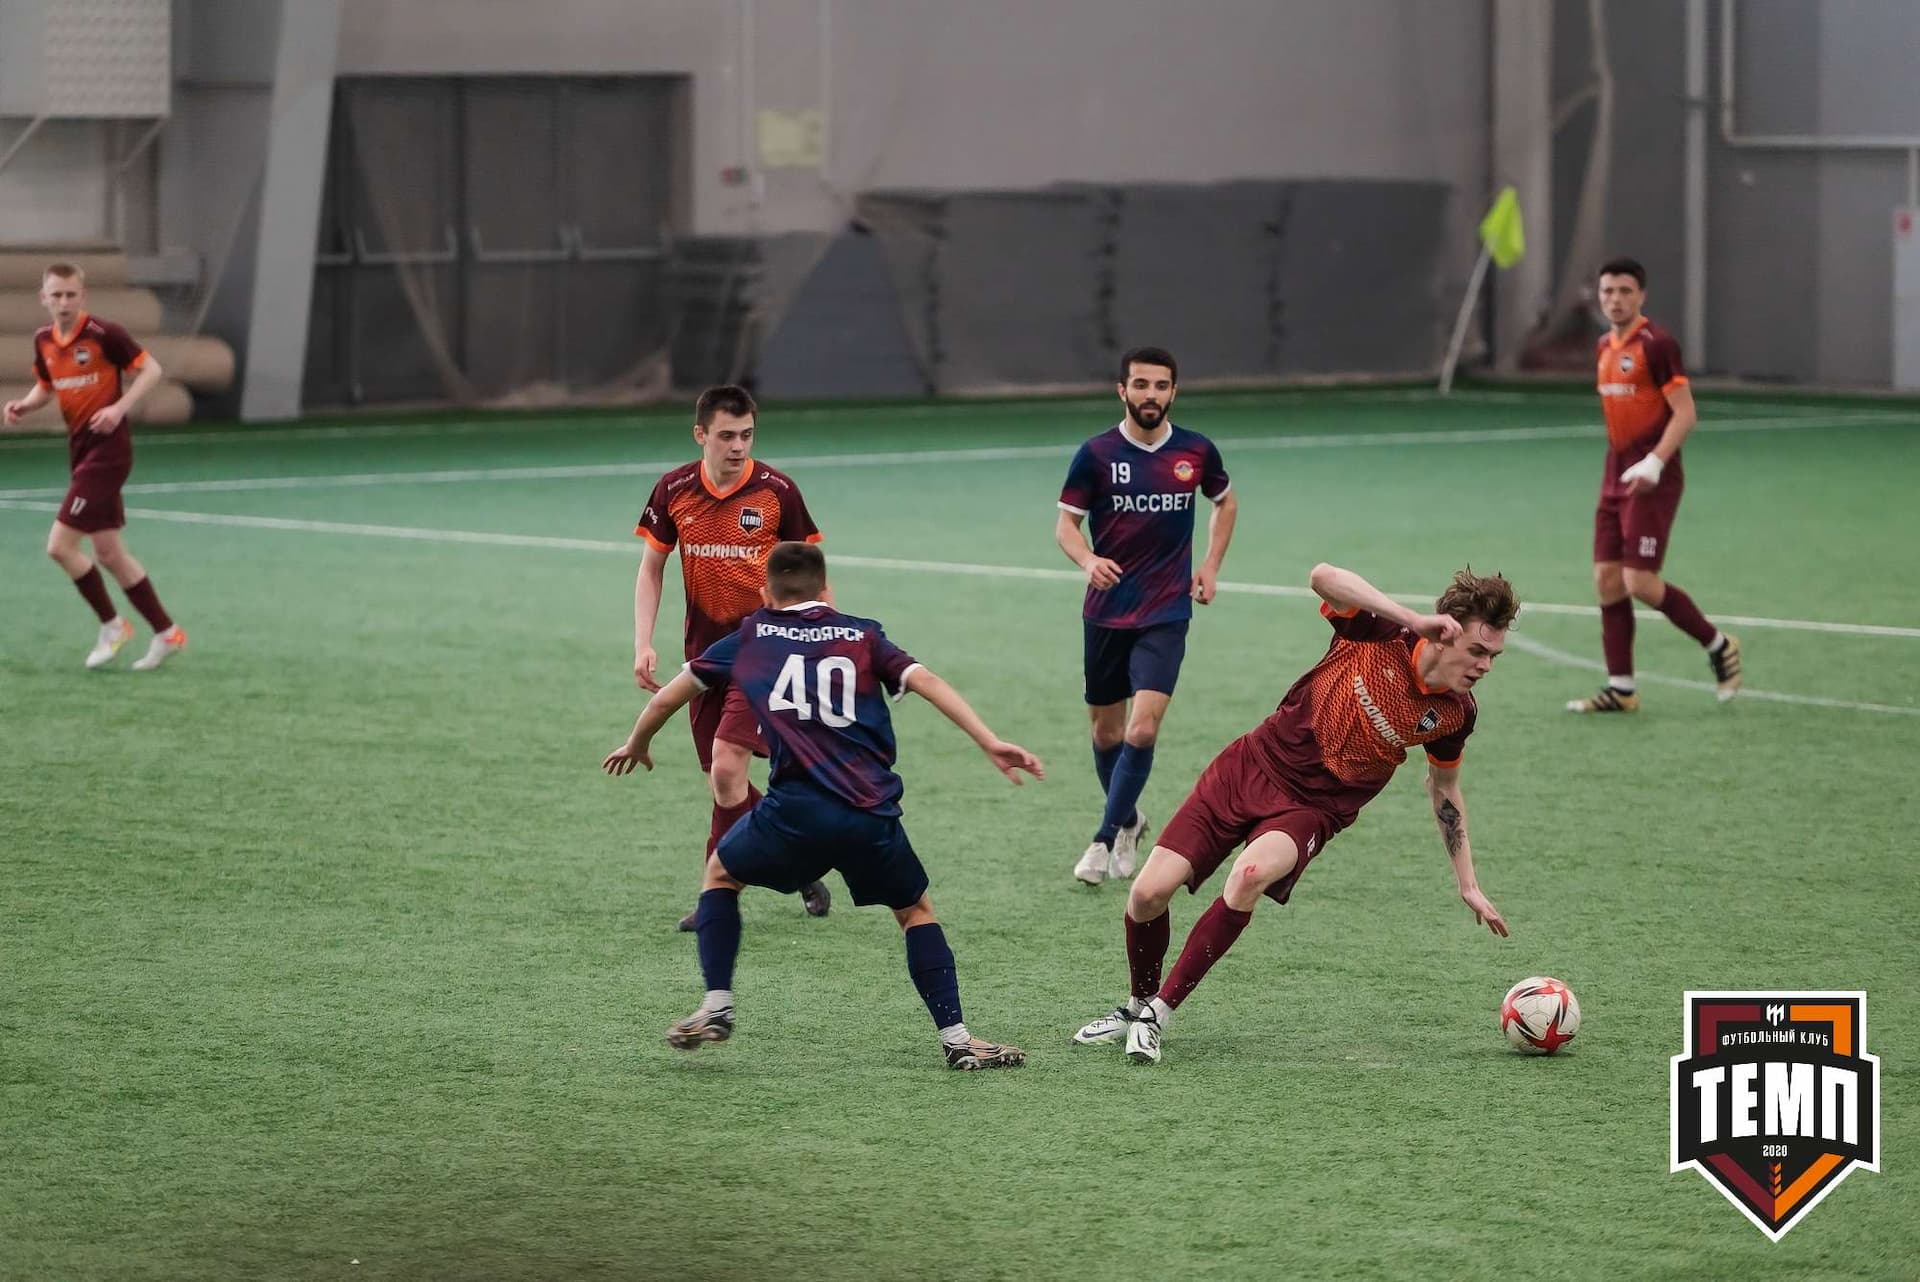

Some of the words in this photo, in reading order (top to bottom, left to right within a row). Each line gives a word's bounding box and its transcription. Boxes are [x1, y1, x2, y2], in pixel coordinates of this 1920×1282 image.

[1111, 462, 1131, 484] 19
[1112, 493, 1192, 512] РАССВЕТ
[684, 543, 762, 559] РОДИНВЕСТ
[756, 623, 865, 642] КРАСНОЯРСК
[768, 653, 857, 727] 40
[1354, 675, 1407, 747] ПРОДИНВЕС
